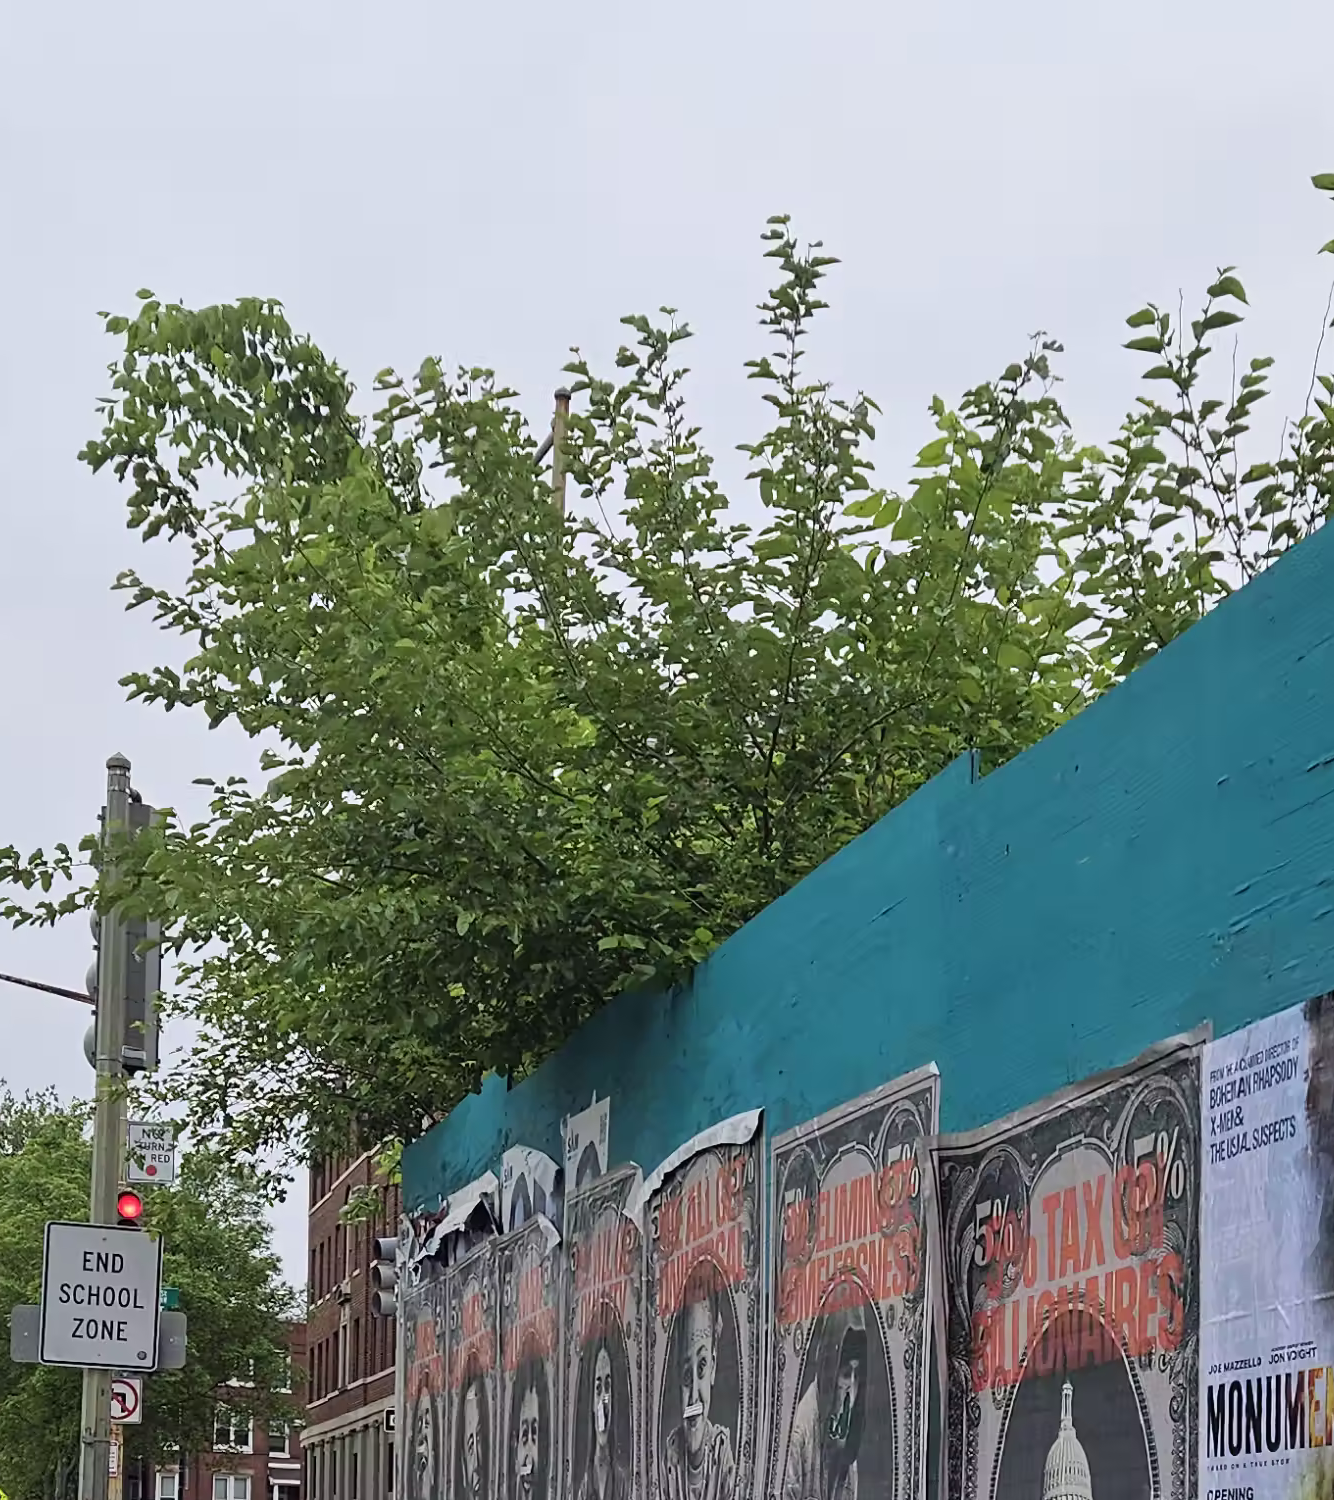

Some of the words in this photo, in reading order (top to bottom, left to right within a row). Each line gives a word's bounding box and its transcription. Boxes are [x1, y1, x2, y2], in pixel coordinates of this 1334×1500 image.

[151, 1154, 171, 1164] RED
[1041, 1174, 1105, 1284] TAX
[82, 1250, 125, 1274] END
[58, 1282, 145, 1310] SCHOOL
[71, 1317, 128, 1342] ZONE
